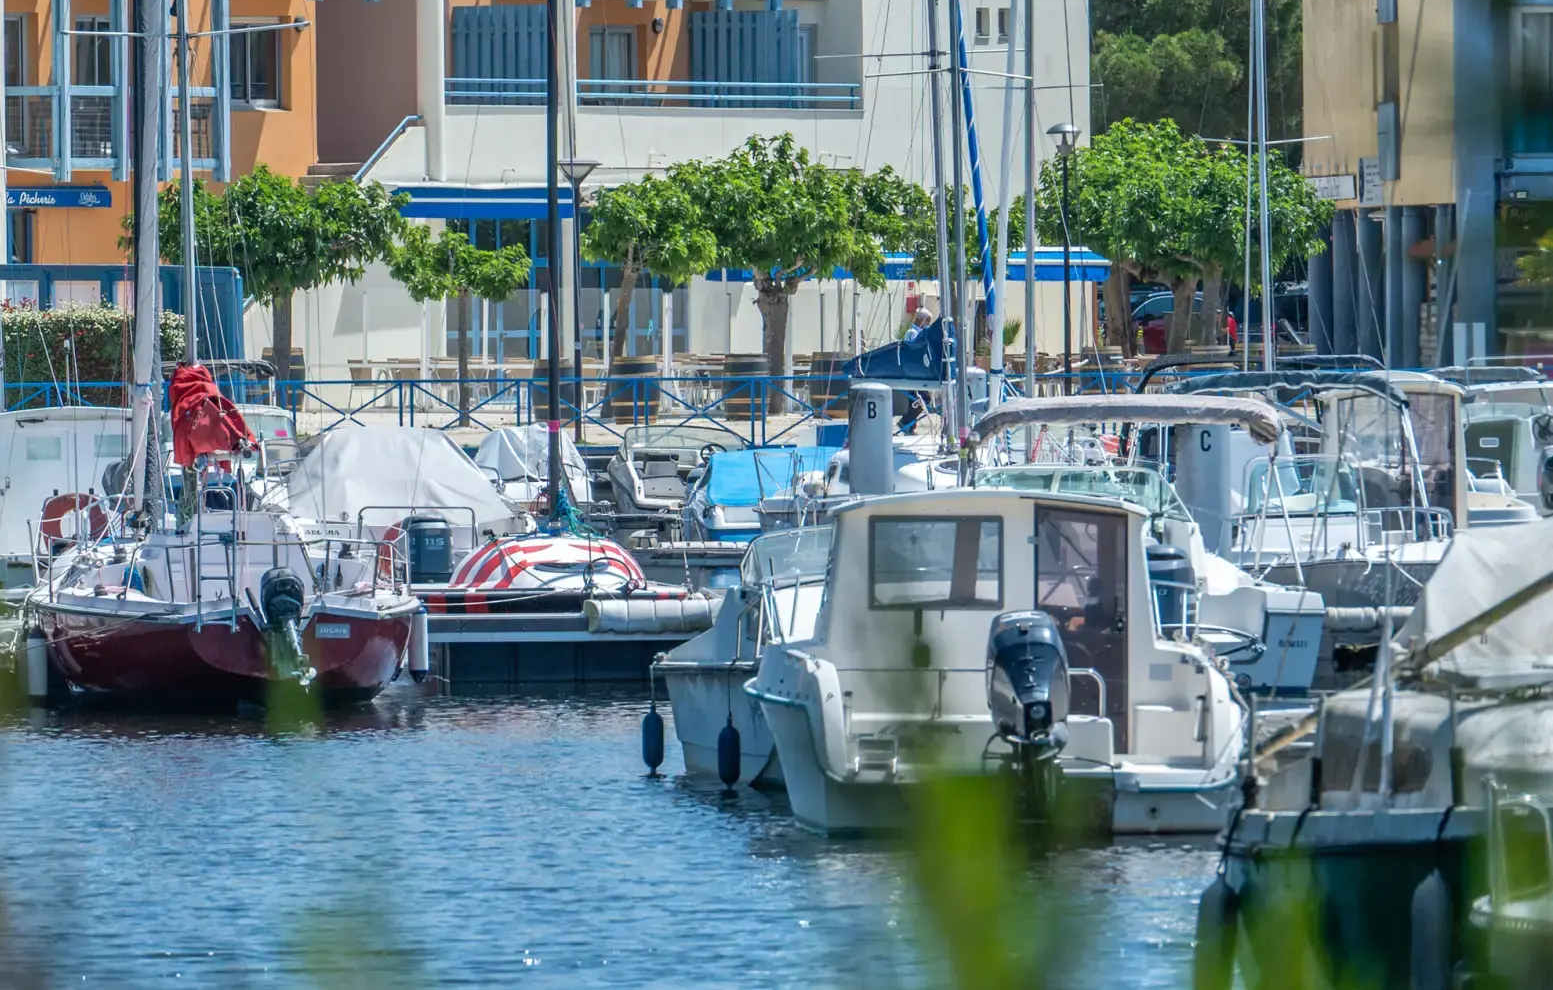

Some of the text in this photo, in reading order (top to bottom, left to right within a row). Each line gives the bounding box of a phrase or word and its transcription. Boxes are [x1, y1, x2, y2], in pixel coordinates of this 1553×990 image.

[19, 191, 57, 206] Pêcherie
[867, 401, 877, 419] B
[1200, 429, 1212, 452] C
[424, 537, 445, 546] 115
